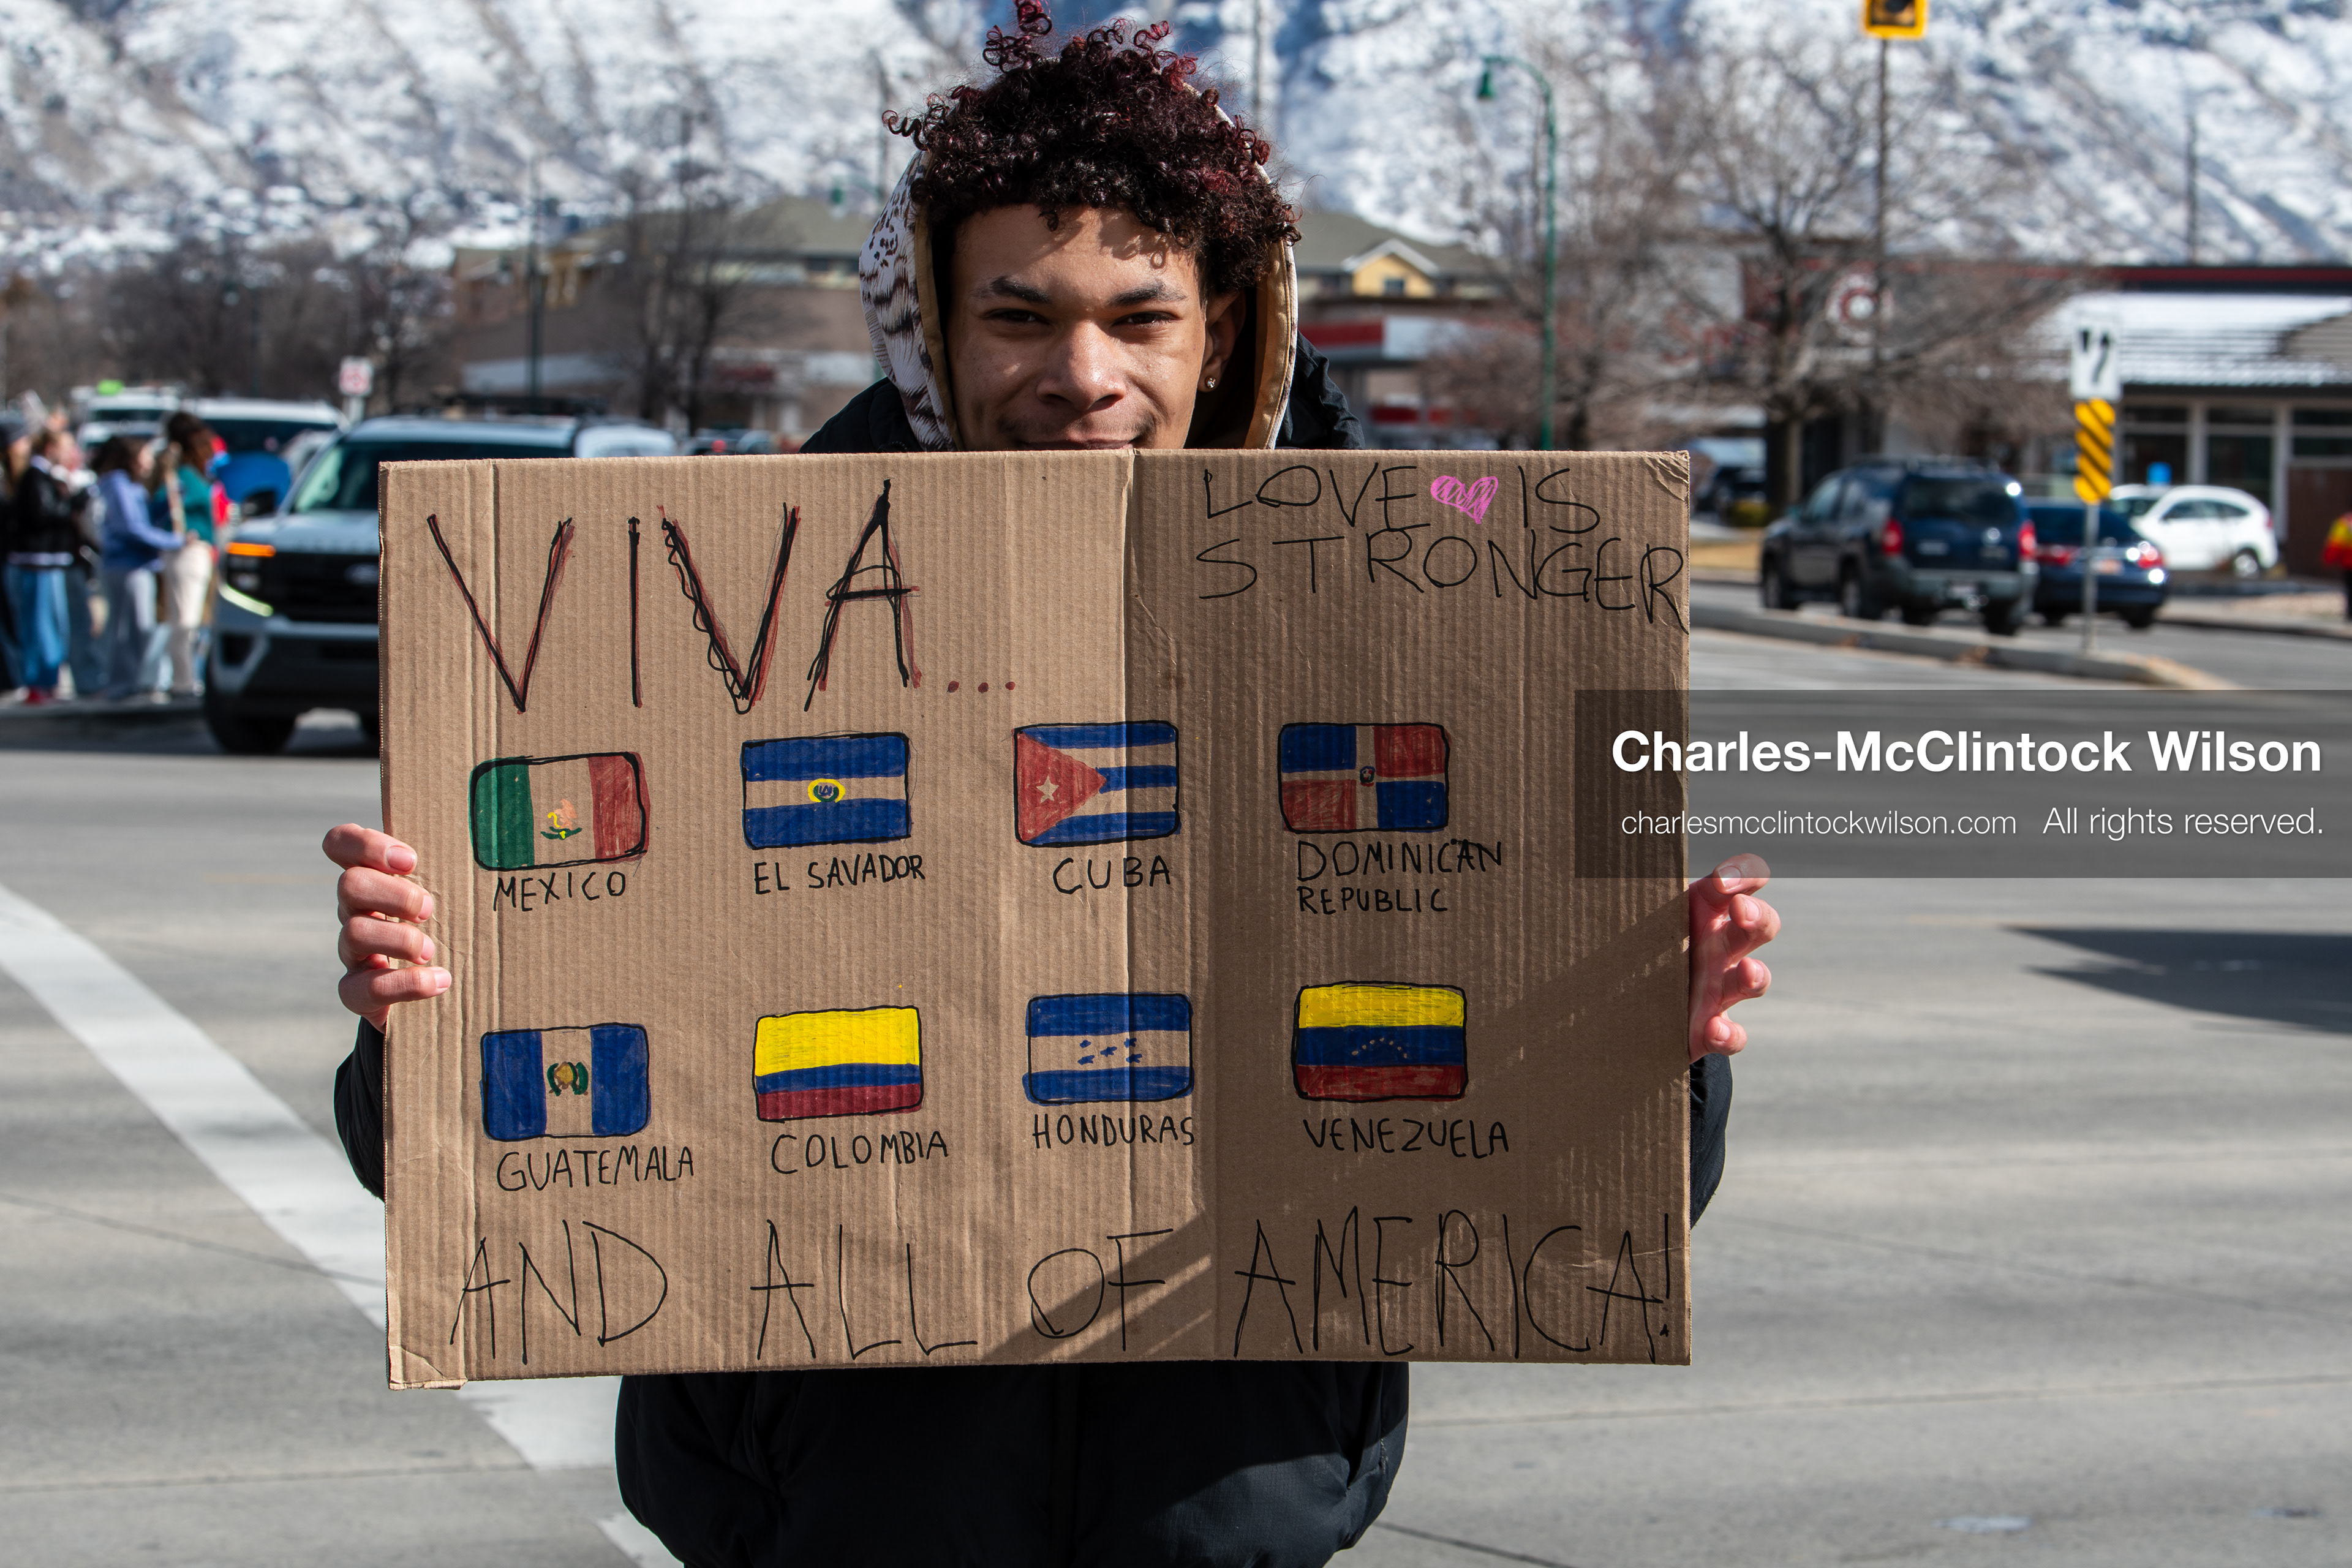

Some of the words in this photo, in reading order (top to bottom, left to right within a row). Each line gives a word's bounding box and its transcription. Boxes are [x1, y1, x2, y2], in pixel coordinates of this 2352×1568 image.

[1204, 462, 1431, 530] LOVE
[1517, 464, 1600, 534] IS
[1196, 528, 1689, 635] STRONGER
[753, 861, 790, 895] EL
[807, 853, 925, 889] SAVADOR
[1052, 855, 1171, 894] CUBA
[1297, 838, 1502, 882] DOMINICAN
[492, 870, 626, 913] MEXICO
[1297, 886, 1449, 915] REPUBLIC
[771, 1130, 949, 1174] COLOMBIA
[1031, 1113, 1195, 1150] HONDURAS
[1302, 1117, 1509, 1159] VENEZUELA
[496, 1145, 695, 1191] GUATEMALA
[450, 1219, 668, 1365] AND
[750, 1219, 978, 1360] ALL
[1027, 1228, 1174, 1352] OF
[1232, 1205, 1672, 1364] AMERICA!
